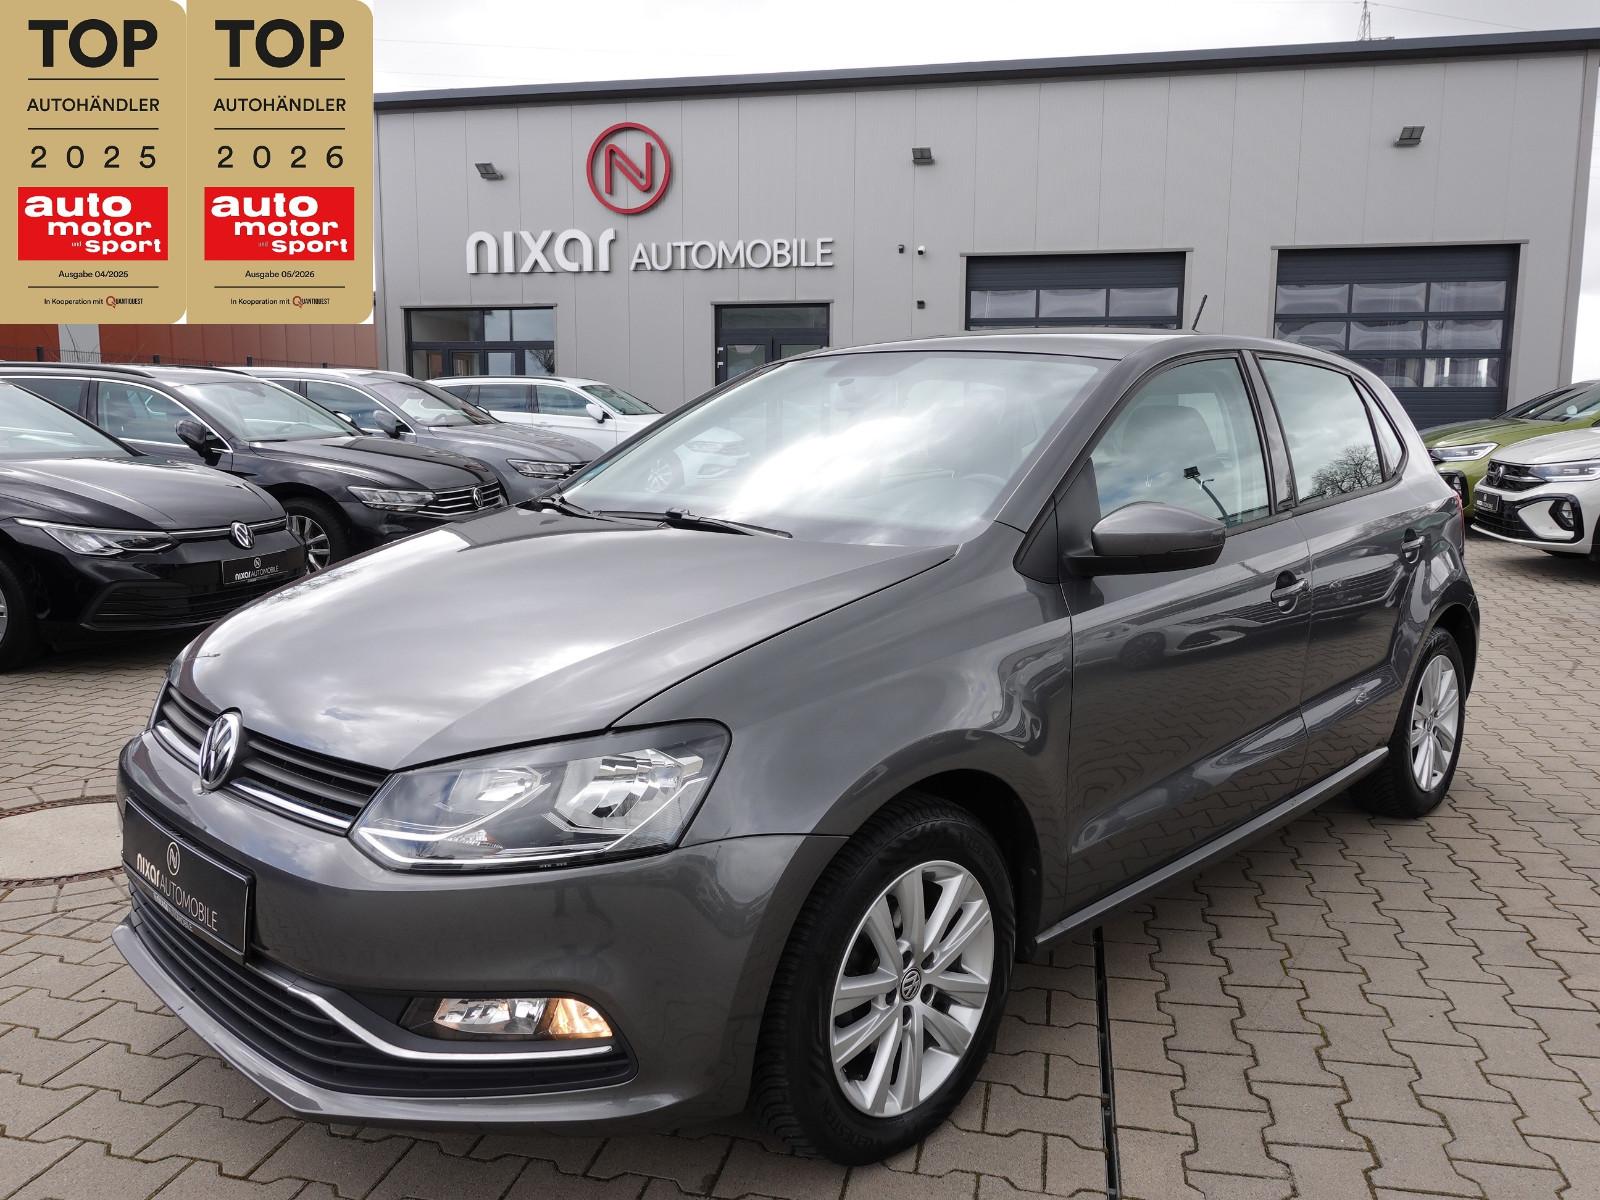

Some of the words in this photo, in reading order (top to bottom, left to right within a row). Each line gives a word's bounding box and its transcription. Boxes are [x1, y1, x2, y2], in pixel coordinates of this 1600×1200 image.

[630, 237, 834, 272] AUTOMOBILE
[250, 565, 279, 576] AUTOMOBILE
[160, 875, 218, 931] AUTOMOBILE
